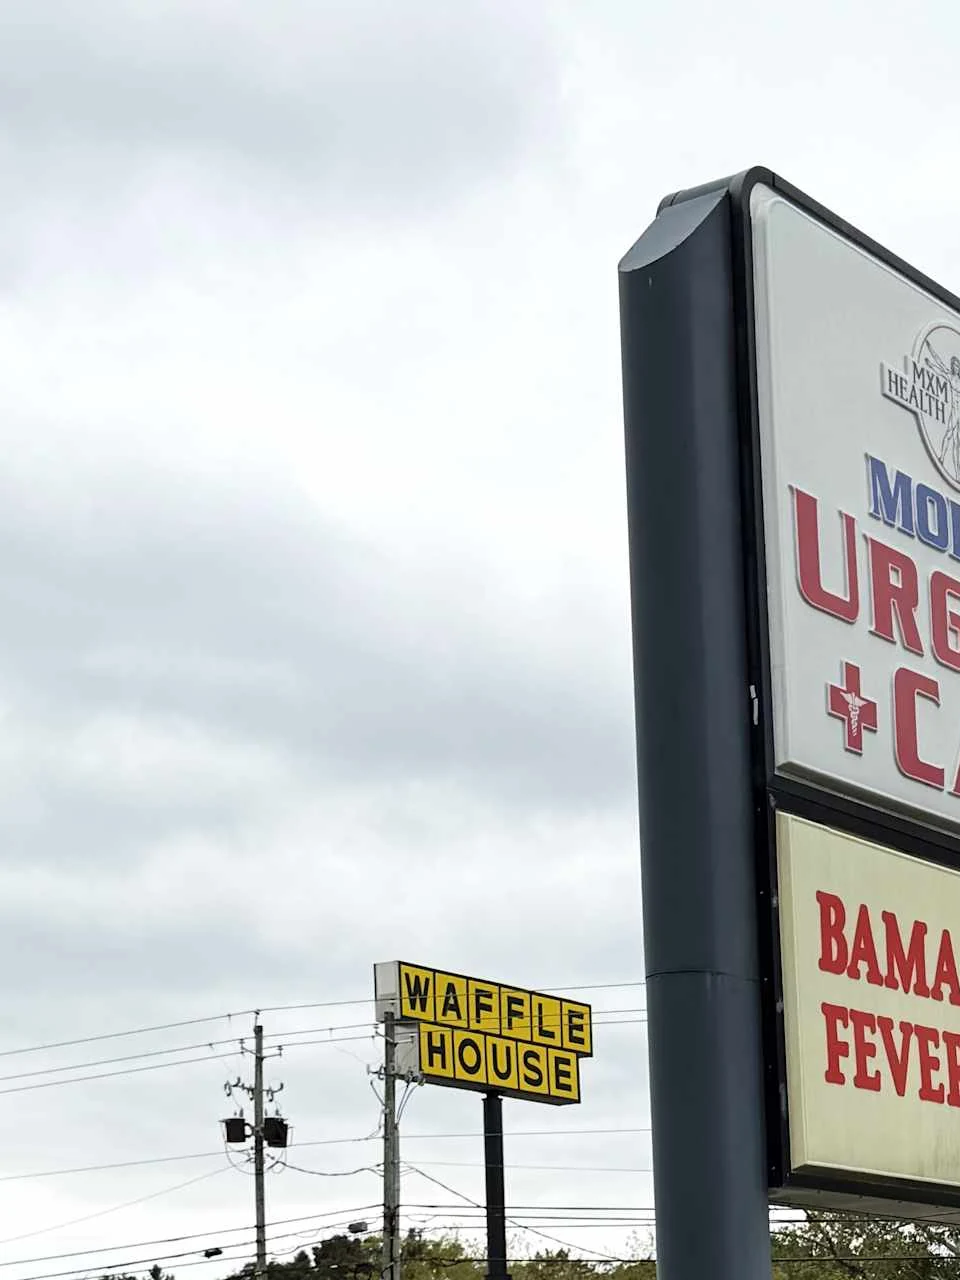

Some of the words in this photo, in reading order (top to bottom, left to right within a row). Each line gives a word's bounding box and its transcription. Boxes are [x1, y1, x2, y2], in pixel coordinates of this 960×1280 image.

[888, 369, 946, 424] HEALTH
[913, 361, 949, 404] MXM
[405, 973, 585, 1046] WAFFLE
[428, 1031, 572, 1092] HOUSE
